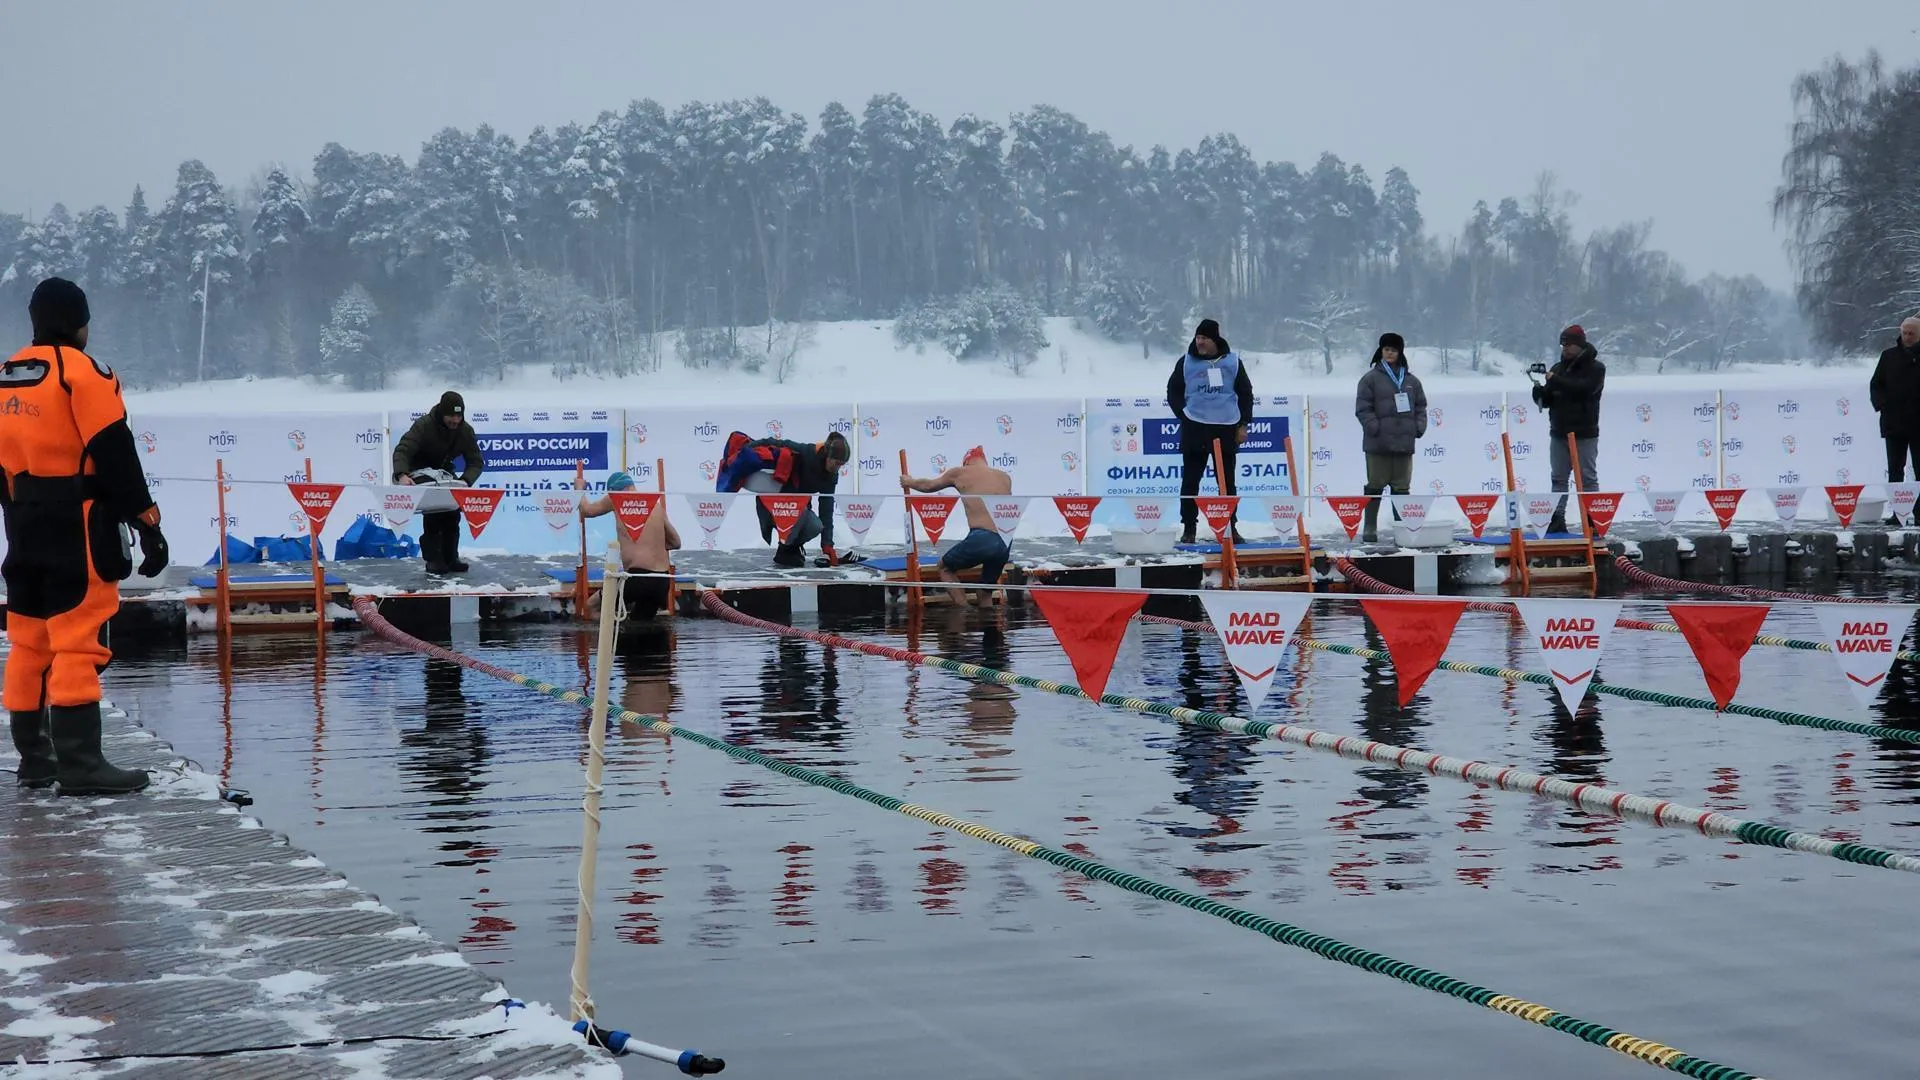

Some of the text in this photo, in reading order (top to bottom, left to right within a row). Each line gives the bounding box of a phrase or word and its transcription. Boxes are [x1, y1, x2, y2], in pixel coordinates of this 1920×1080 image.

[528, 438, 589, 450] РОССИИ
[487, 458, 535, 467] ЗИМНЕМУ
[1241, 463, 1288, 477] ЭТАП
[1135, 486, 1179, 494] 2025-2026
[1255, 483, 1288, 492] область
[301, 500, 332, 508] WAVE
[463, 505, 493, 513] WAVE
[1509, 501, 1516, 520] 5
[1229, 612, 1280, 627] MAD
[1546, 618, 1595, 632] MAD
[1841, 622, 1888, 636] MAD
[1224, 630, 1285, 645] WAVE
[1540, 635, 1600, 649] WAVE
[1835, 638, 1892, 653] WAVE
